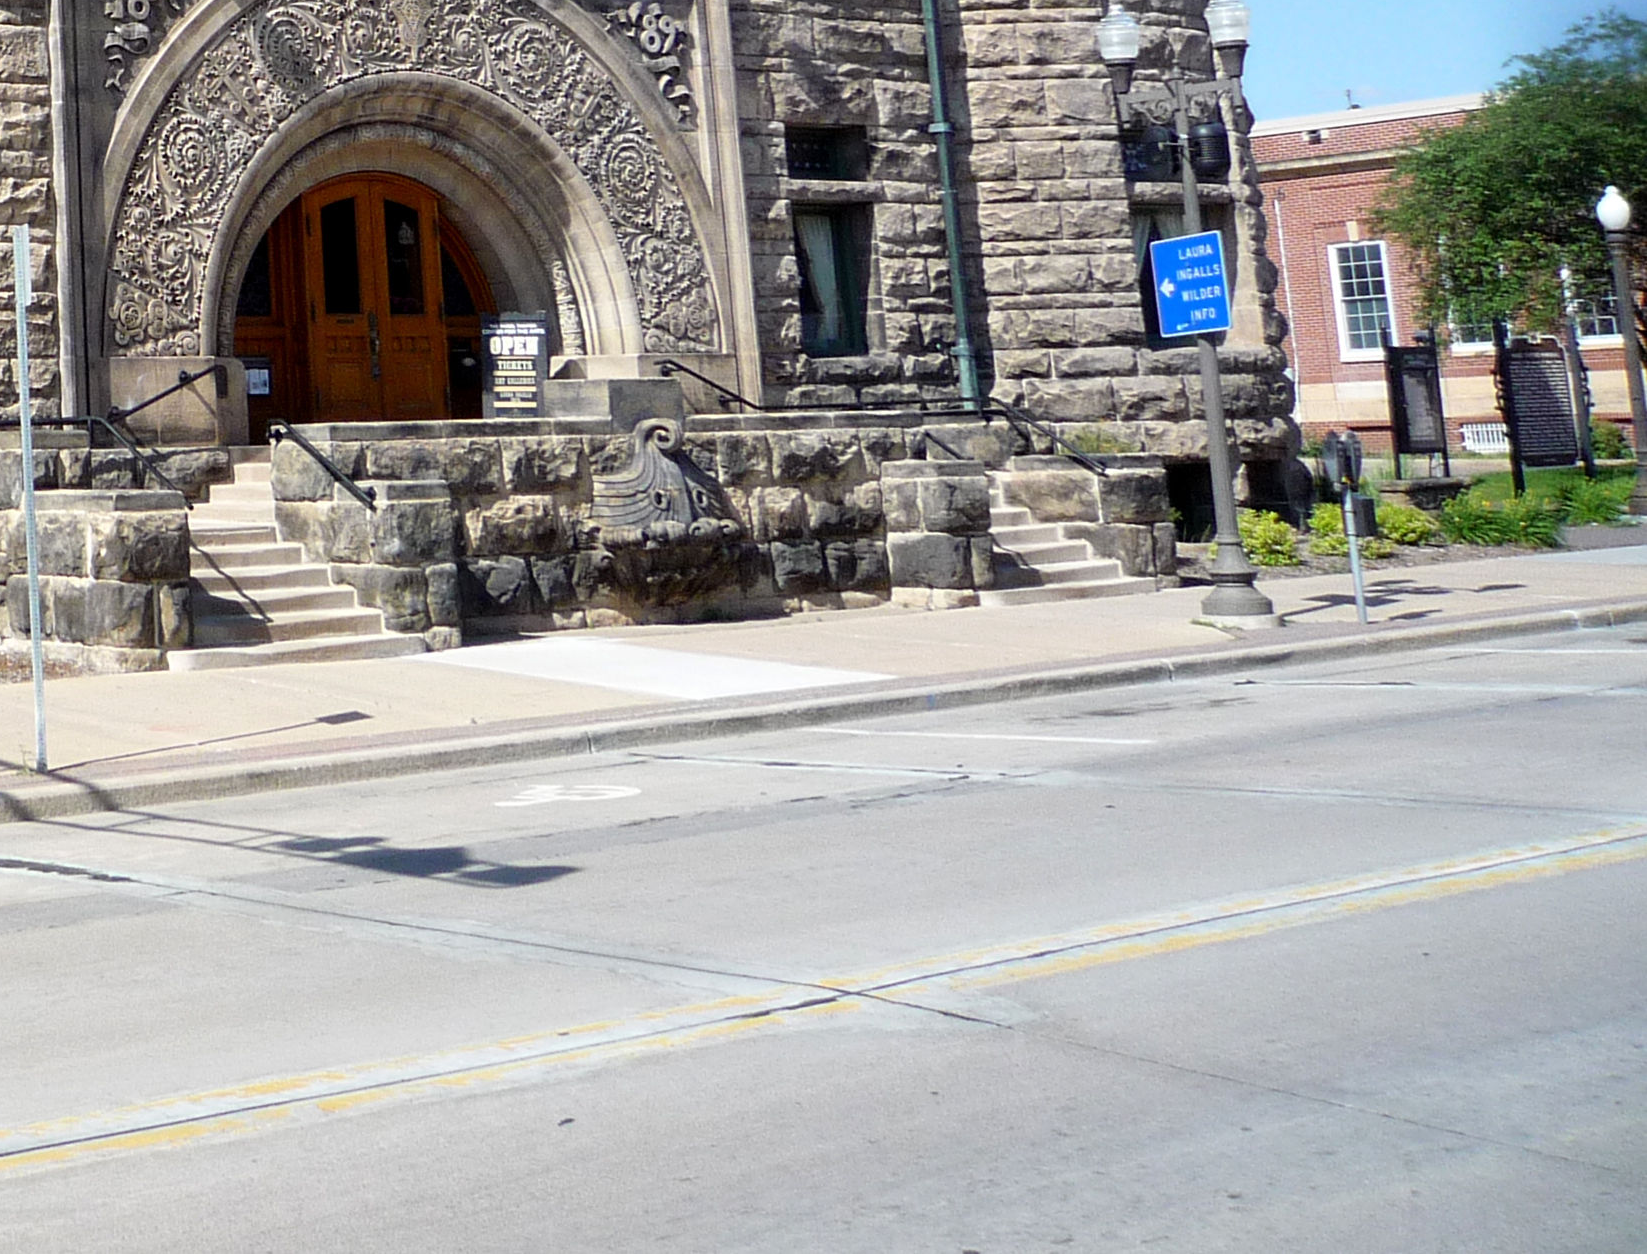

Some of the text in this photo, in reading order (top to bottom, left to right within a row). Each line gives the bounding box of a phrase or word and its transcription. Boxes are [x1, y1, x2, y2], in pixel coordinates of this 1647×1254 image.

[640, 14, 676, 54] 89
[1178, 244, 1213, 260] LAURA
[1176, 264, 1221, 281] INGALLS
[1181, 286, 1221, 302] WILDER
[1190, 308, 1216, 323] INFO
[489, 335, 539, 355] OPEN
